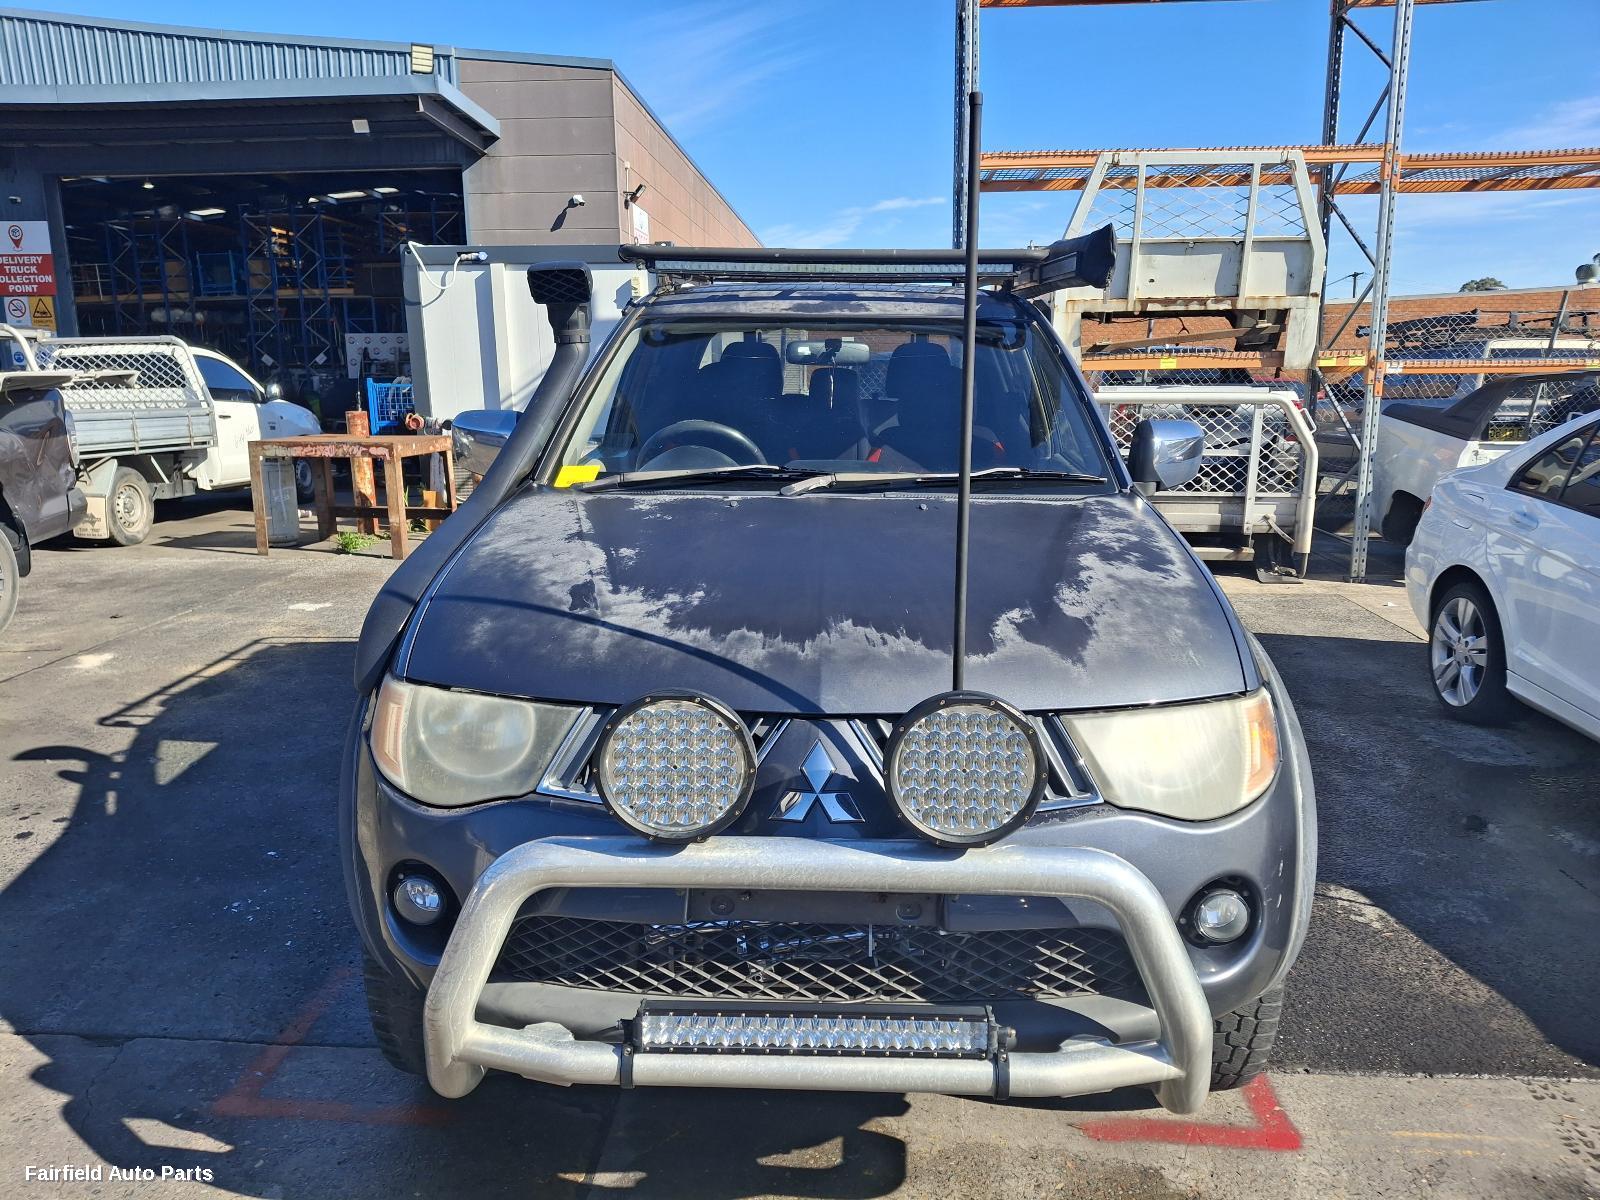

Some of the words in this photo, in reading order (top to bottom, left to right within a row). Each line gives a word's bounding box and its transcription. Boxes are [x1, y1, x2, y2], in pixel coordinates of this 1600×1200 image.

[4, 265, 38, 274] TRUCK
[0, 275, 52, 283] OLLECTION
[8, 284, 38, 293] POINT
